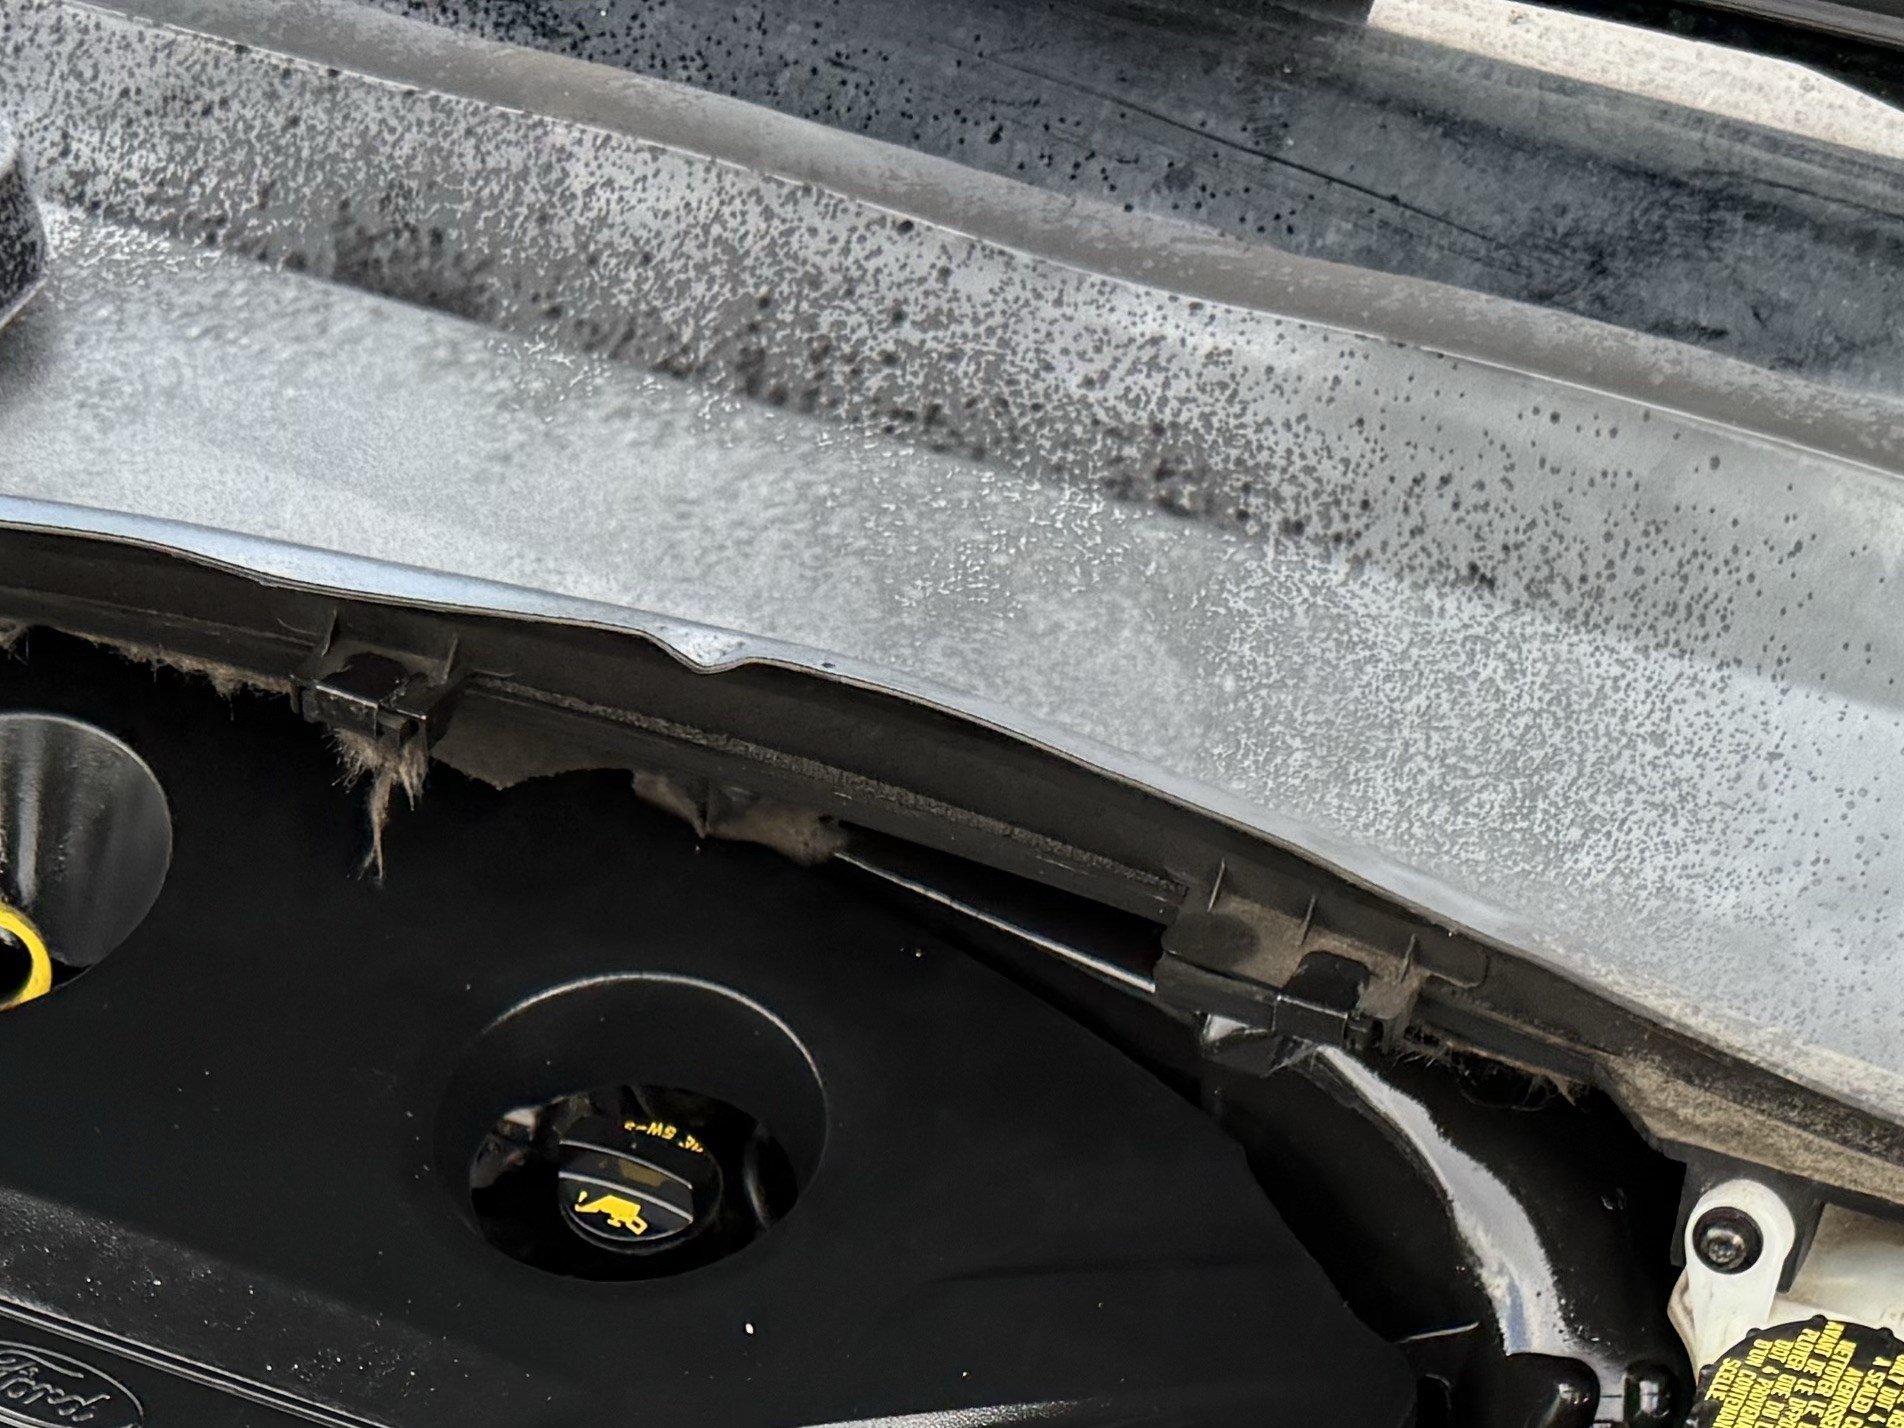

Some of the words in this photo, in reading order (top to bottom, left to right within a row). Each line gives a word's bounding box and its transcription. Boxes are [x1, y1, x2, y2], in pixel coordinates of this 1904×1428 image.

[1768, 1339, 1794, 1363] DOT
[1784, 1328, 1821, 1371] PLOYER
[1814, 1320, 1844, 1358] AVANT
[1743, 1339, 1773, 1367] D'UN
[1803, 1358, 1826, 1377] DE
[1813, 1340, 1856, 1400] NETTOYER
[1770, 1374, 1797, 1400] QUE
[1794, 1378, 1816, 1396] LE
[1851, 1369, 1886, 1413] SEALED
[1875, 1386, 1901, 1412] DOT
[1758, 1398, 1786, 1423] DU
[1803, 1400, 1827, 1418] LE
